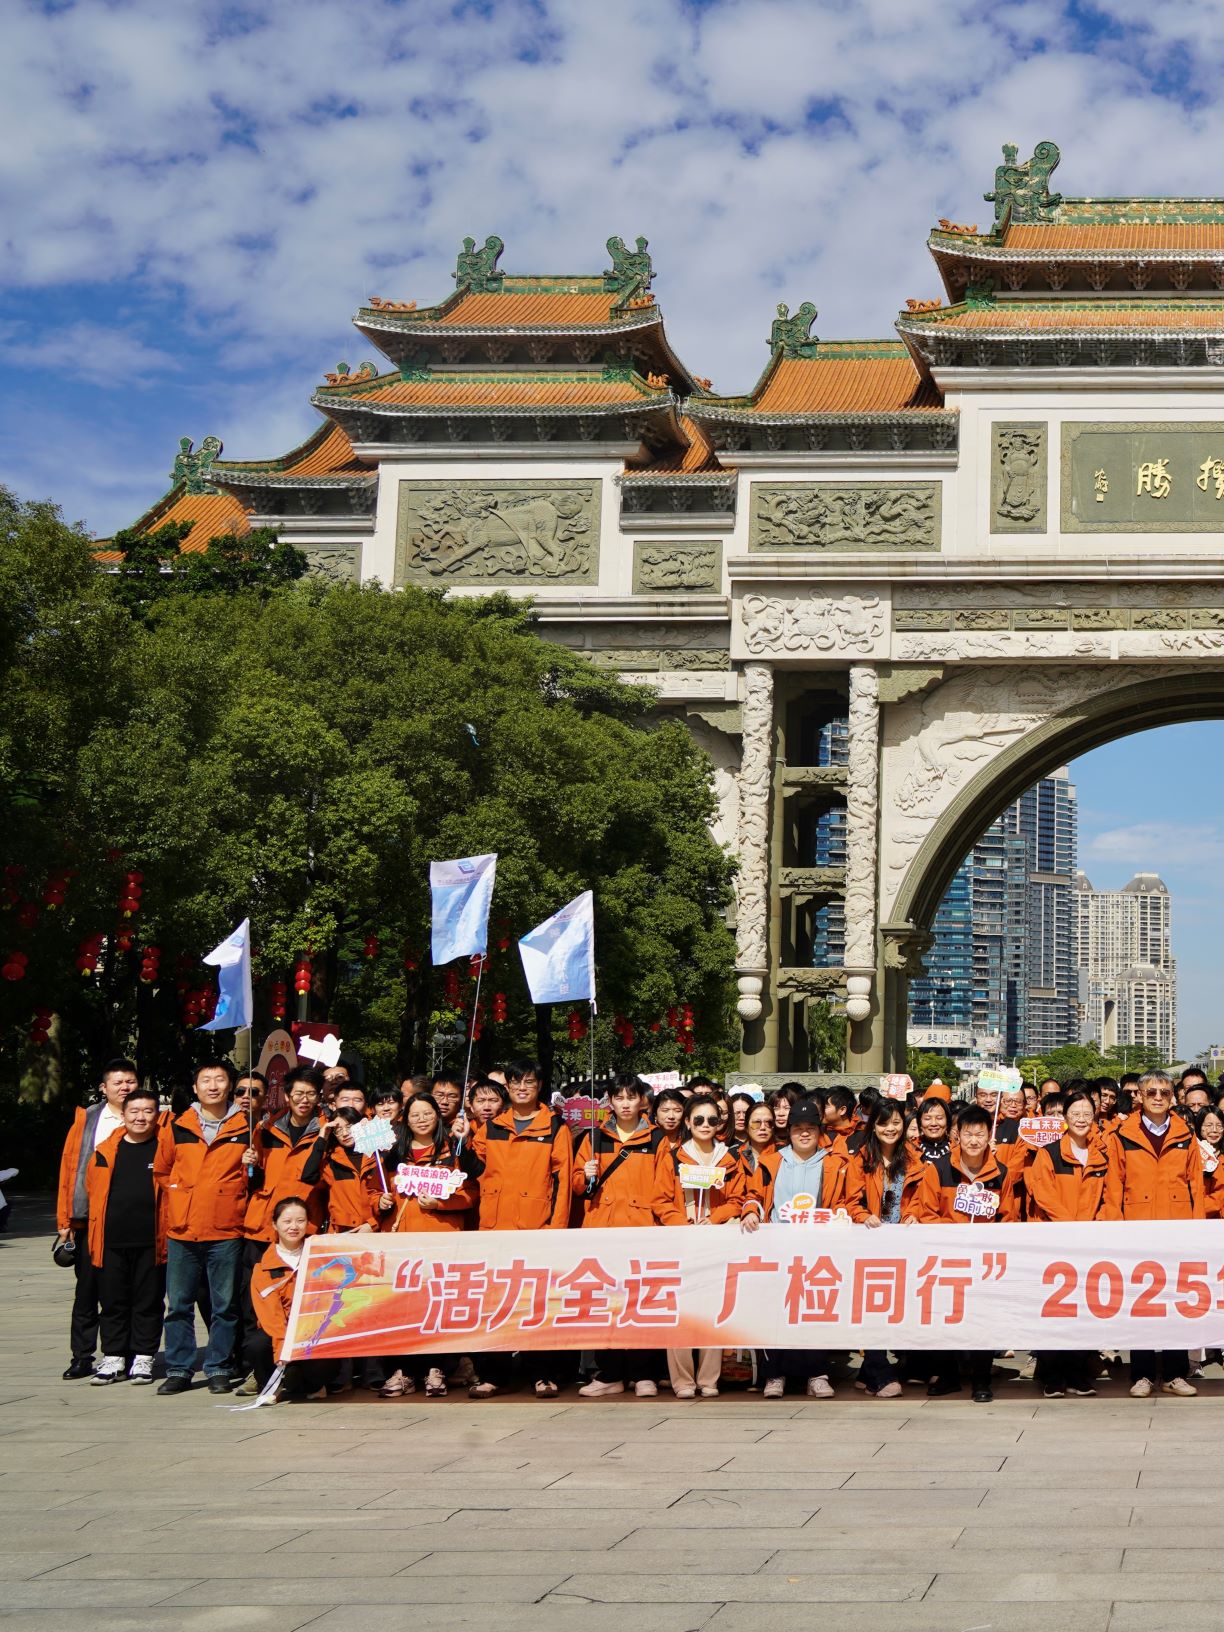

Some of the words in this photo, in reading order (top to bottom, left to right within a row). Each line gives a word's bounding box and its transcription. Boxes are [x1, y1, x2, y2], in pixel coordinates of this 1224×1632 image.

[402, 1167, 449, 1180] 乘风破浪的
[392, 1257, 682, 1334] “活力全运
[715, 1252, 1008, 1328] 广检同行”
